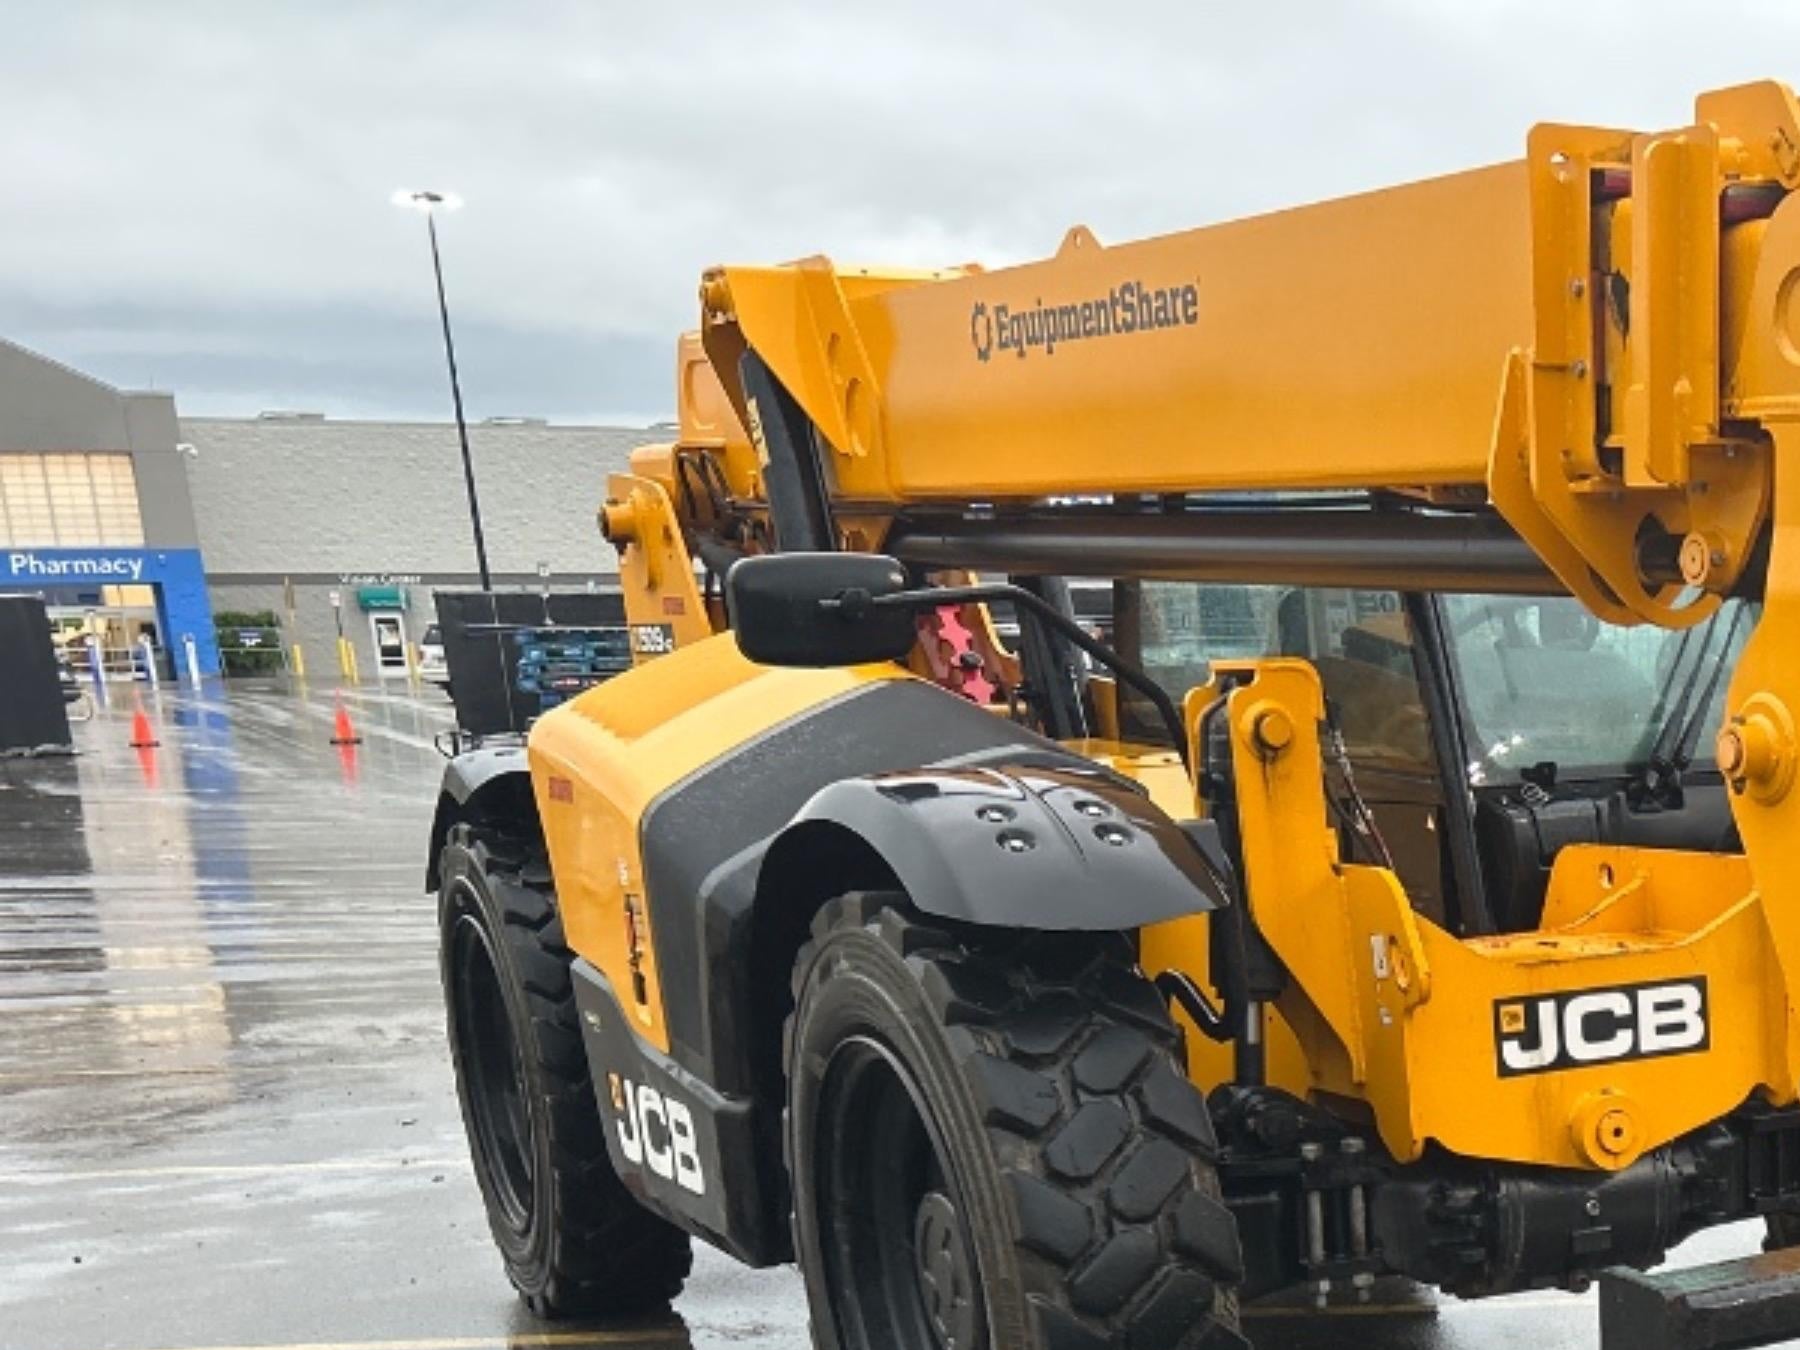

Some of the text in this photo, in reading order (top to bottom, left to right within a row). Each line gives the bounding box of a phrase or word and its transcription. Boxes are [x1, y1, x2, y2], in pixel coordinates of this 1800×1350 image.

[995, 280, 1199, 359] EquipmentShare
[9, 553, 143, 581] Pharmacy
[1501, 984, 1706, 1070] JCB
[616, 1079, 706, 1196] JCB
